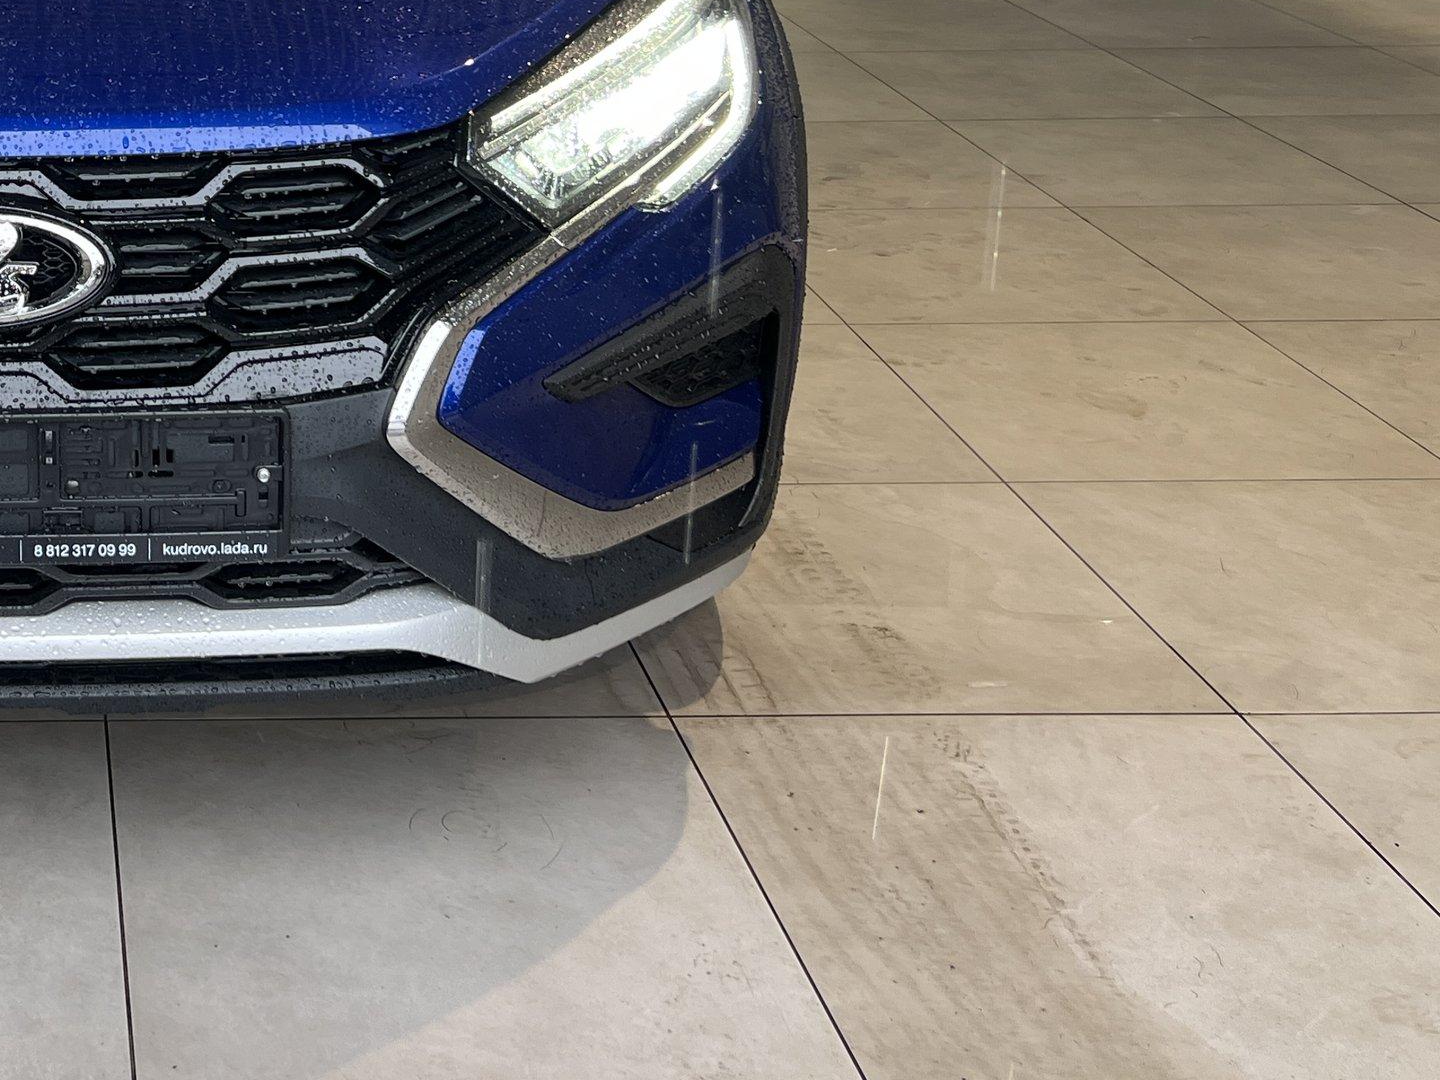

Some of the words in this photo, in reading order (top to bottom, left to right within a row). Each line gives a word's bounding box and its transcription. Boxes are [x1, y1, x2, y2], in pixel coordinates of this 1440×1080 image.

[33, 544, 43, 558] 8
[45, 544, 70, 558] 812
[72, 544, 95, 557] 317
[97, 543, 116, 557] 09
[118, 543, 137, 557] 99
[162, 541, 268, 556] kudrovo.lada.ru
